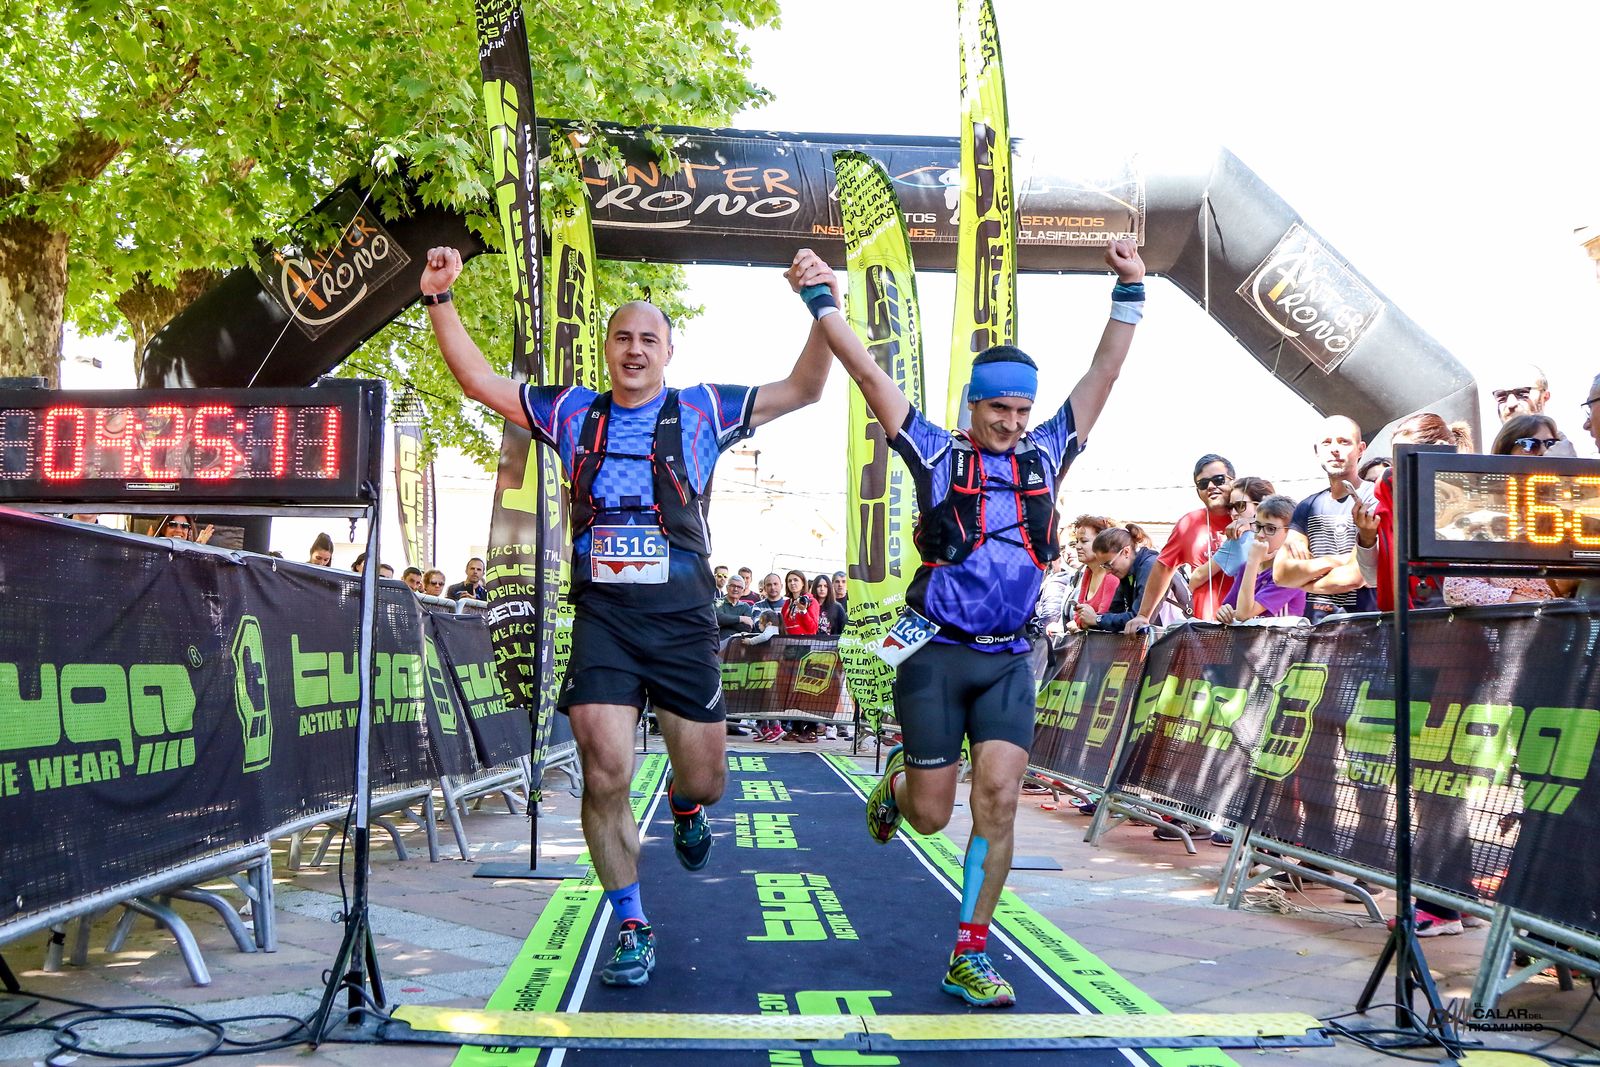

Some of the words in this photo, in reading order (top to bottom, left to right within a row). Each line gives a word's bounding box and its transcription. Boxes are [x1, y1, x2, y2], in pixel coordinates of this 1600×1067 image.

[1020, 215, 1105, 227] SERVICIOS
[1018, 230, 1138, 242] CLASIFICACIONES
[889, 470, 904, 578] ACTIVE
[603, 536, 657, 556] 1516
[892, 616, 927, 642] 1149
[299, 709, 344, 737] ACTIVE
[29, 750, 121, 792] WEAR
[1412, 767, 1491, 800] WEAR
